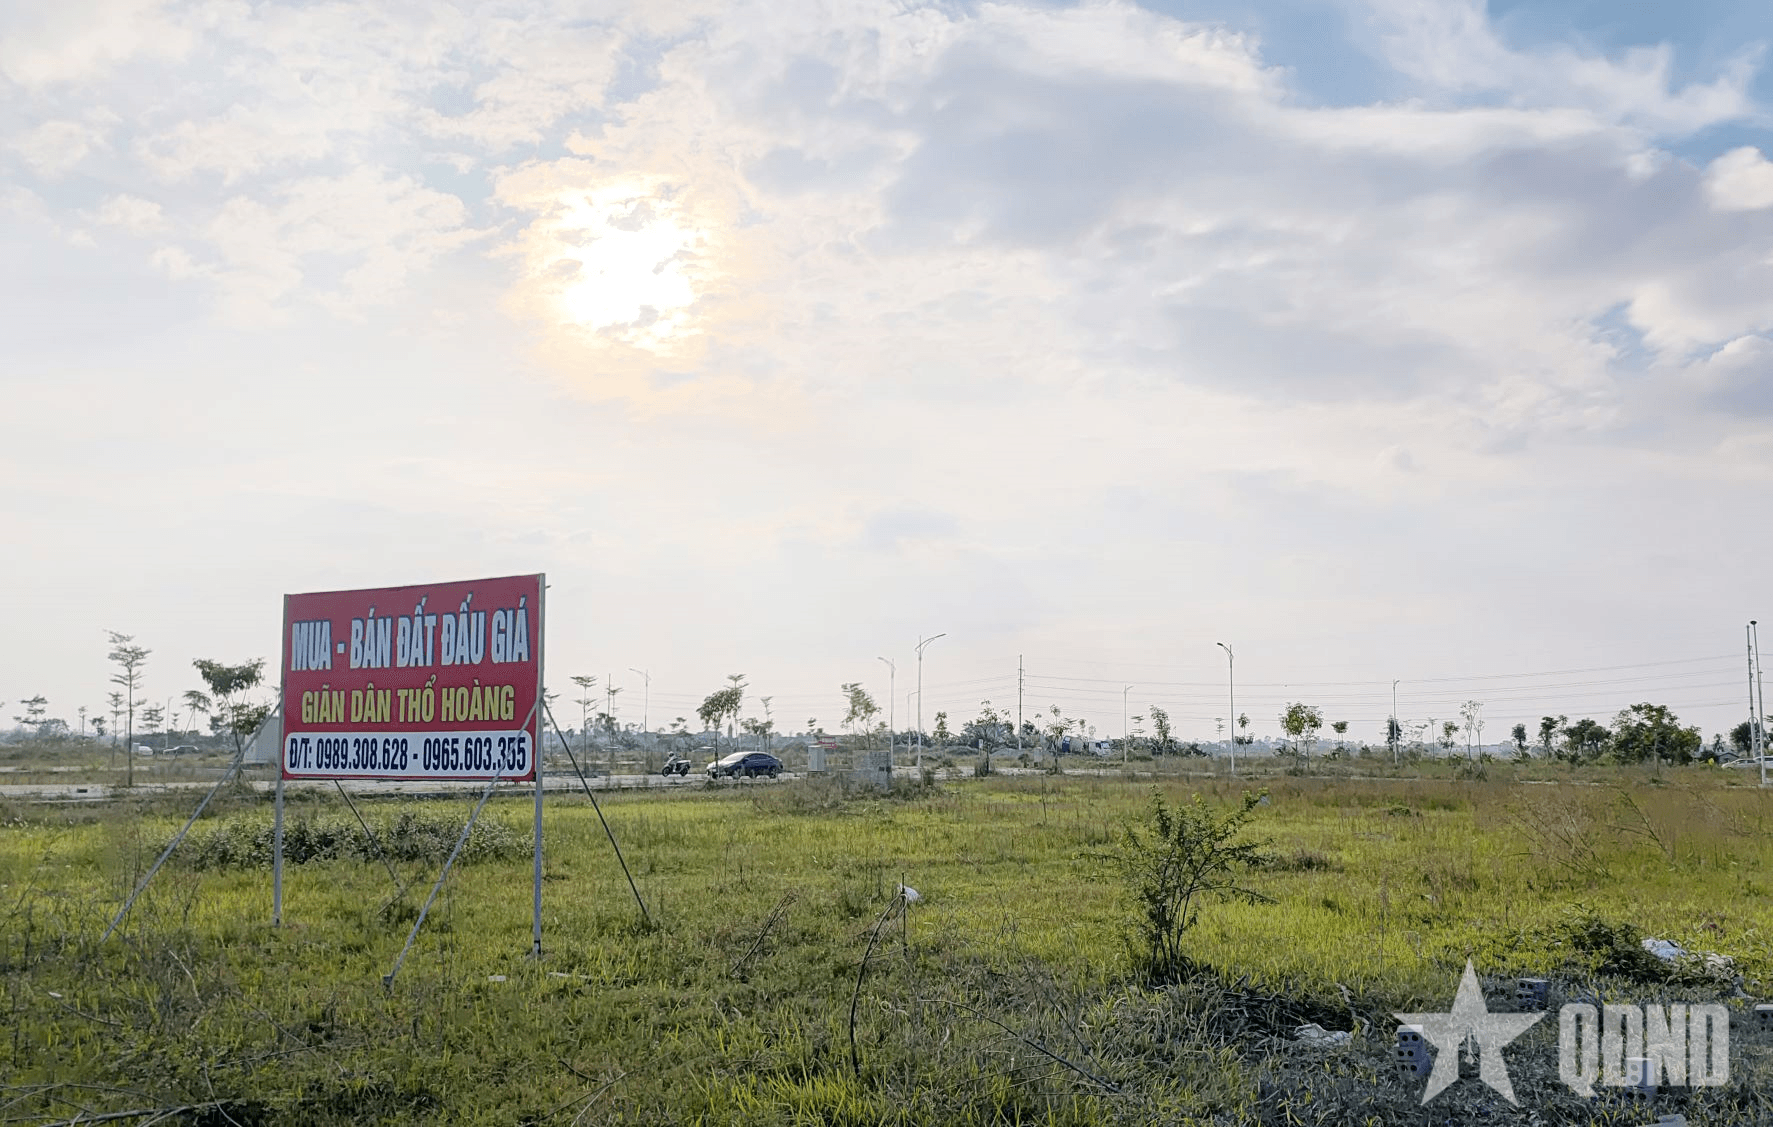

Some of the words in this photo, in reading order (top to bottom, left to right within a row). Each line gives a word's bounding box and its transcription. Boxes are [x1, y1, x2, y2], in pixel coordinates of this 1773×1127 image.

[291, 620, 332, 671] MUA
[350, 606, 392, 669] BÁN
[397, 596, 437, 668] ĐẤT
[441, 592, 486, 666] ĐẤU
[490, 595, 529, 664] GIÁ
[301, 684, 345, 724] GIÃN
[350, 682, 391, 723] DÂN
[397, 674, 436, 722] THỔ
[441, 679, 515, 721] HOÀNG
[289, 738, 312, 769] Đ/T:
[316, 737, 408, 770] 0989.308.628
[423, 736, 526, 771] 0965.603.355
